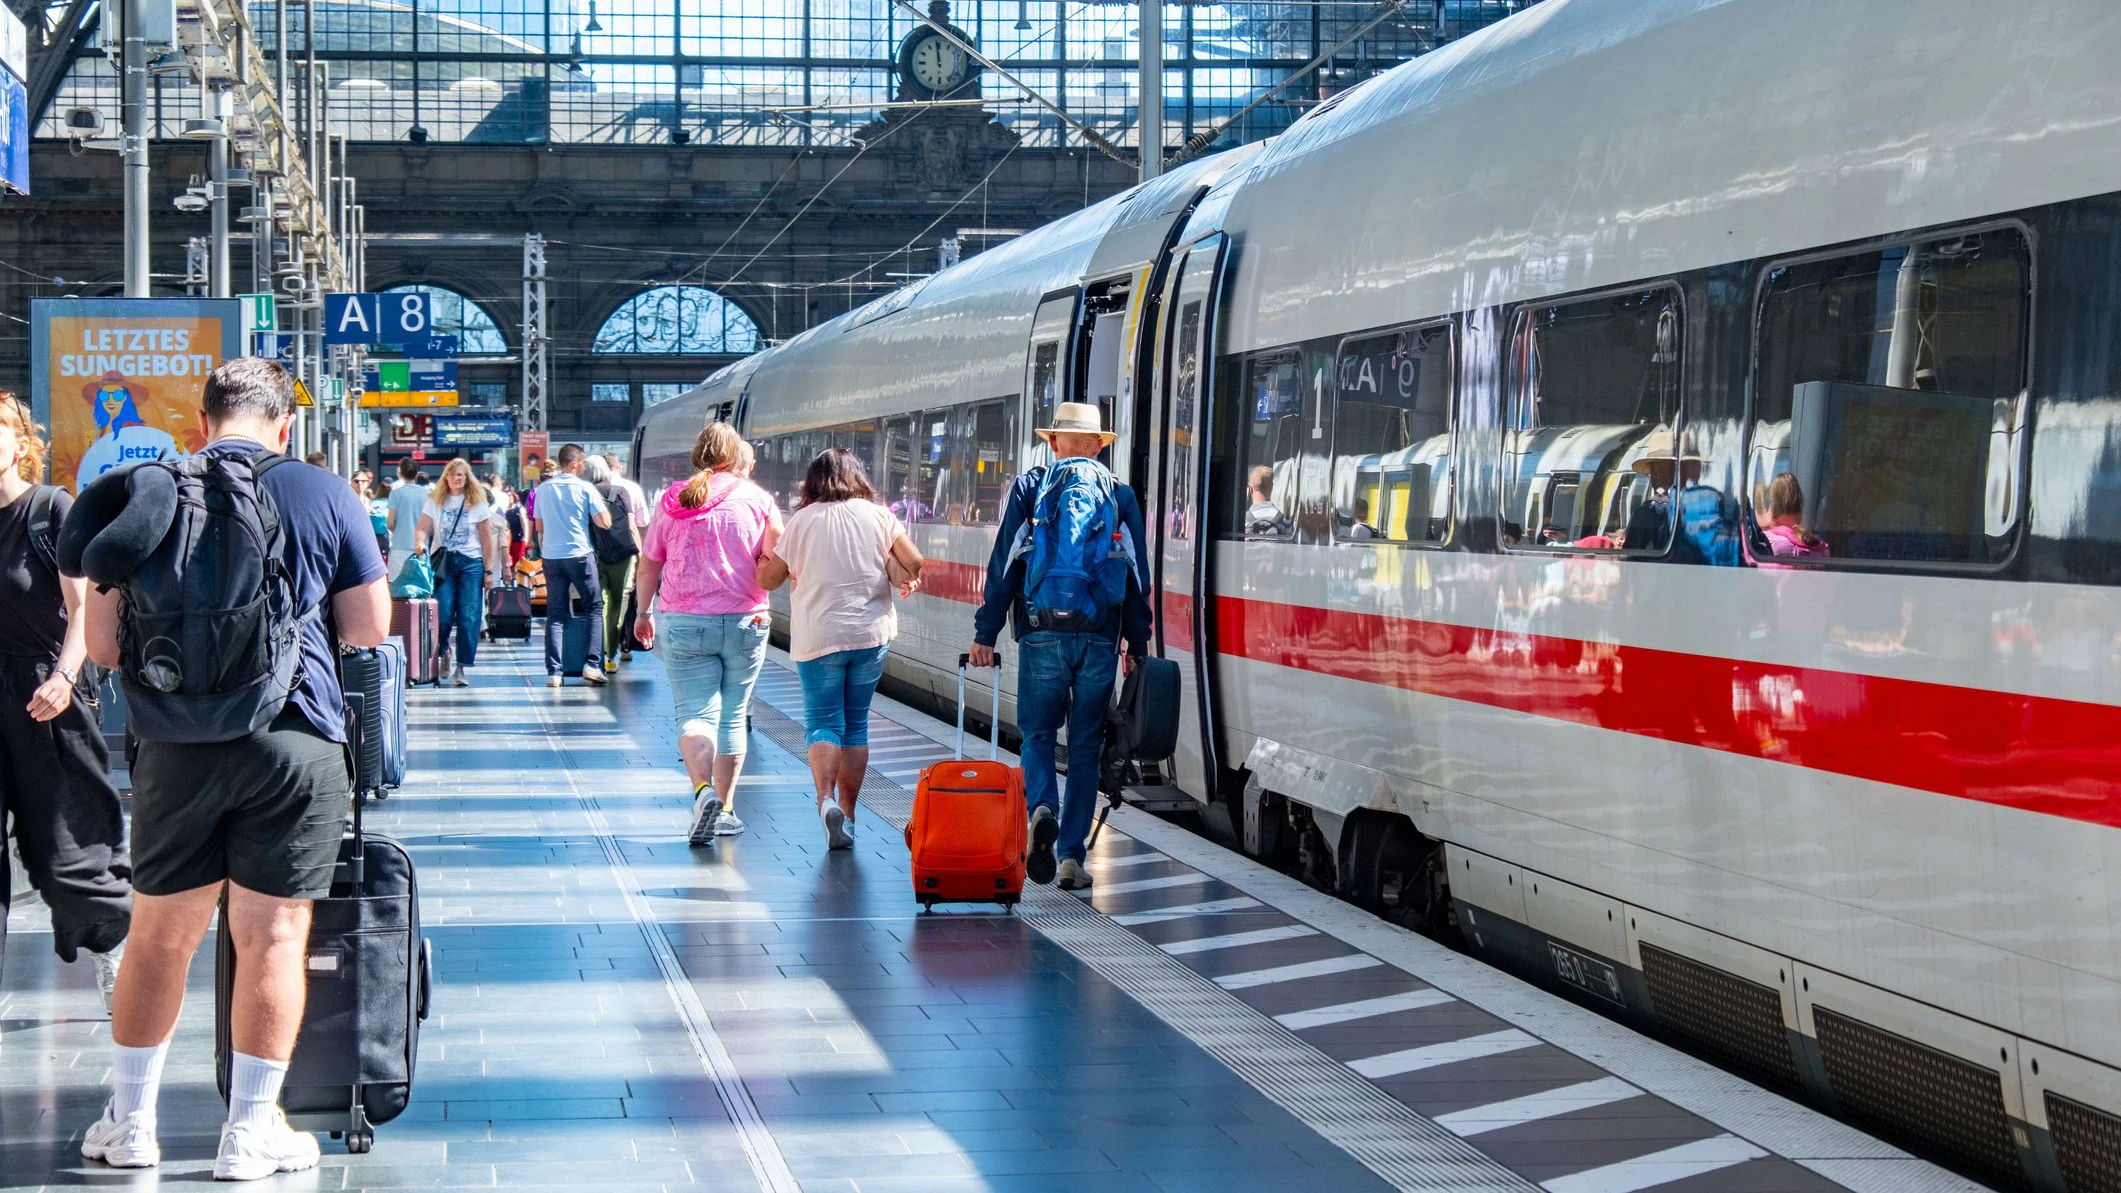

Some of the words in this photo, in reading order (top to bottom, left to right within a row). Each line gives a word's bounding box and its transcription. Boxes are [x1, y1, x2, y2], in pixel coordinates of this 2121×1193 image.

[338, 296, 369, 332] A
[400, 294, 425, 332] 8
[83, 329, 190, 351] LETZTES
[60, 354, 213, 376] SUNGEBOT!
[1311, 368, 1323, 439] 1
[399, 413, 433, 438] DB
[117, 445, 158, 462] Jetzt
[1552, 947, 1576, 981] 265
